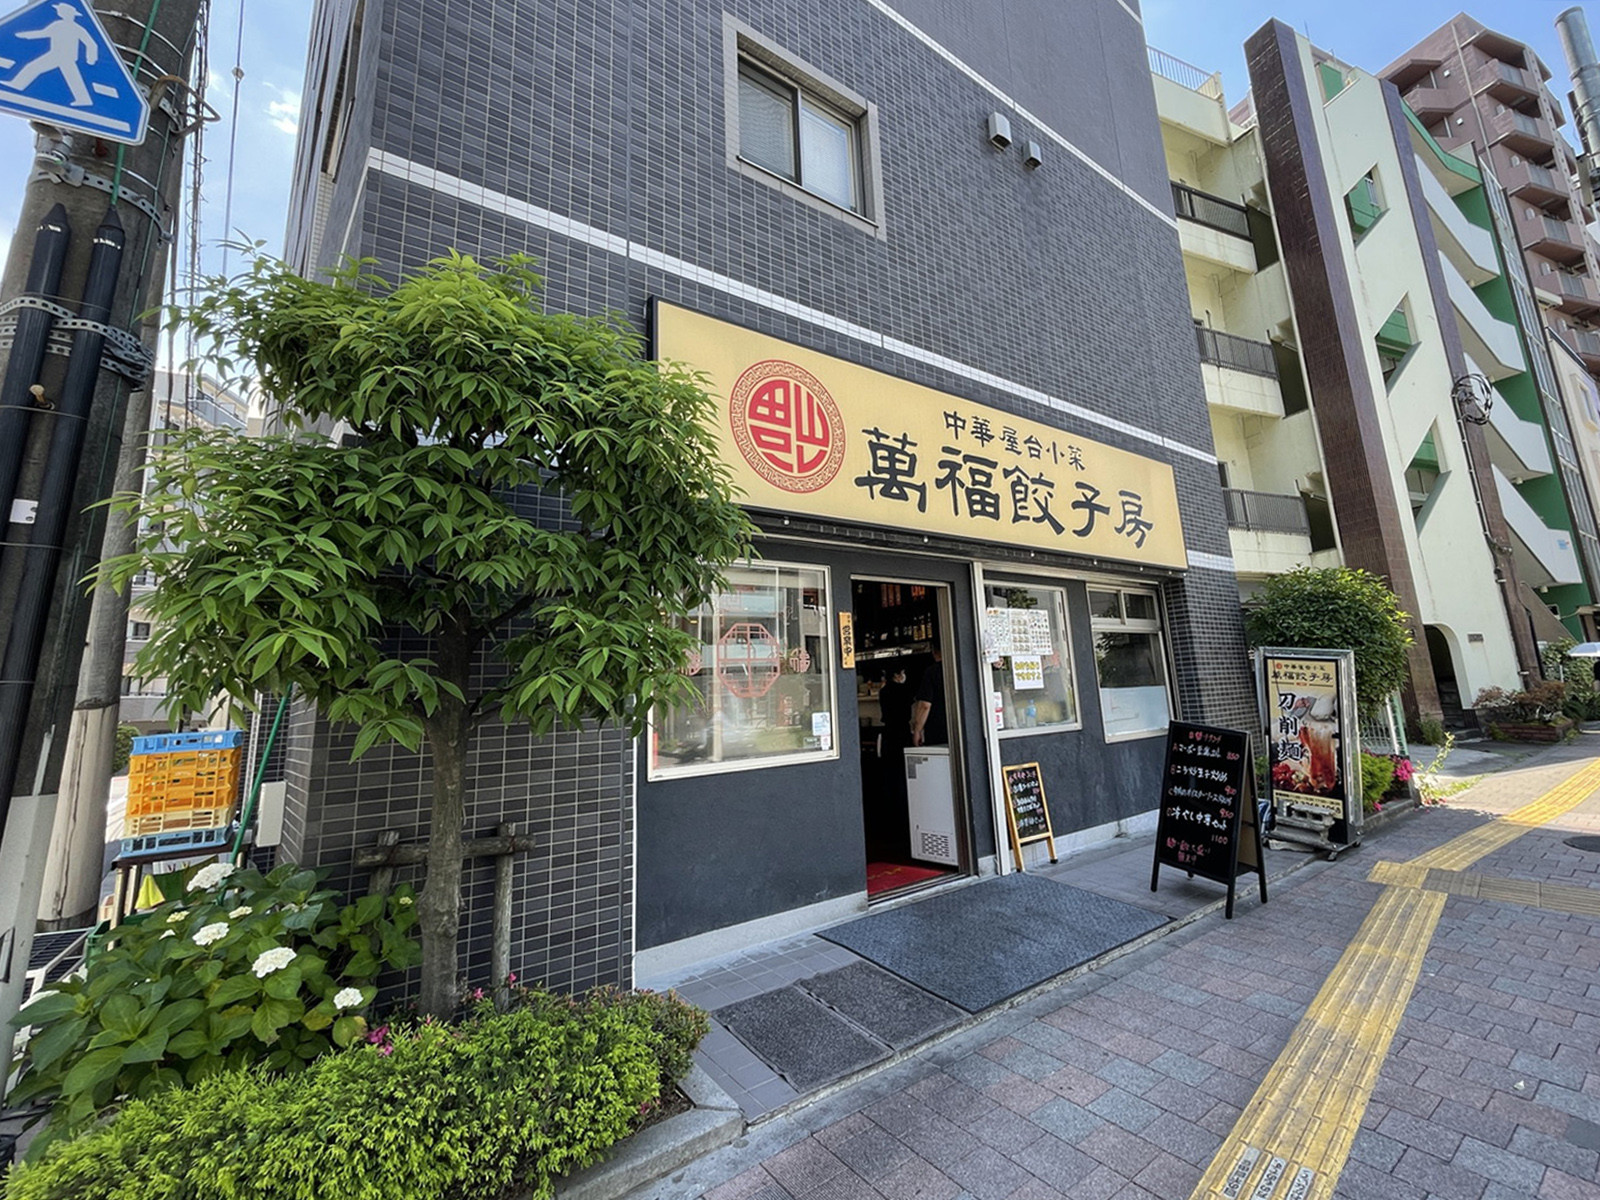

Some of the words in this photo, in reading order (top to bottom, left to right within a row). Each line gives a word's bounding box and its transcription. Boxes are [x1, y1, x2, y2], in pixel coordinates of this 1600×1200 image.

[942, 410, 1086, 472] 中華屋台小菜
[853, 426, 1154, 549] 萬福餃子房
